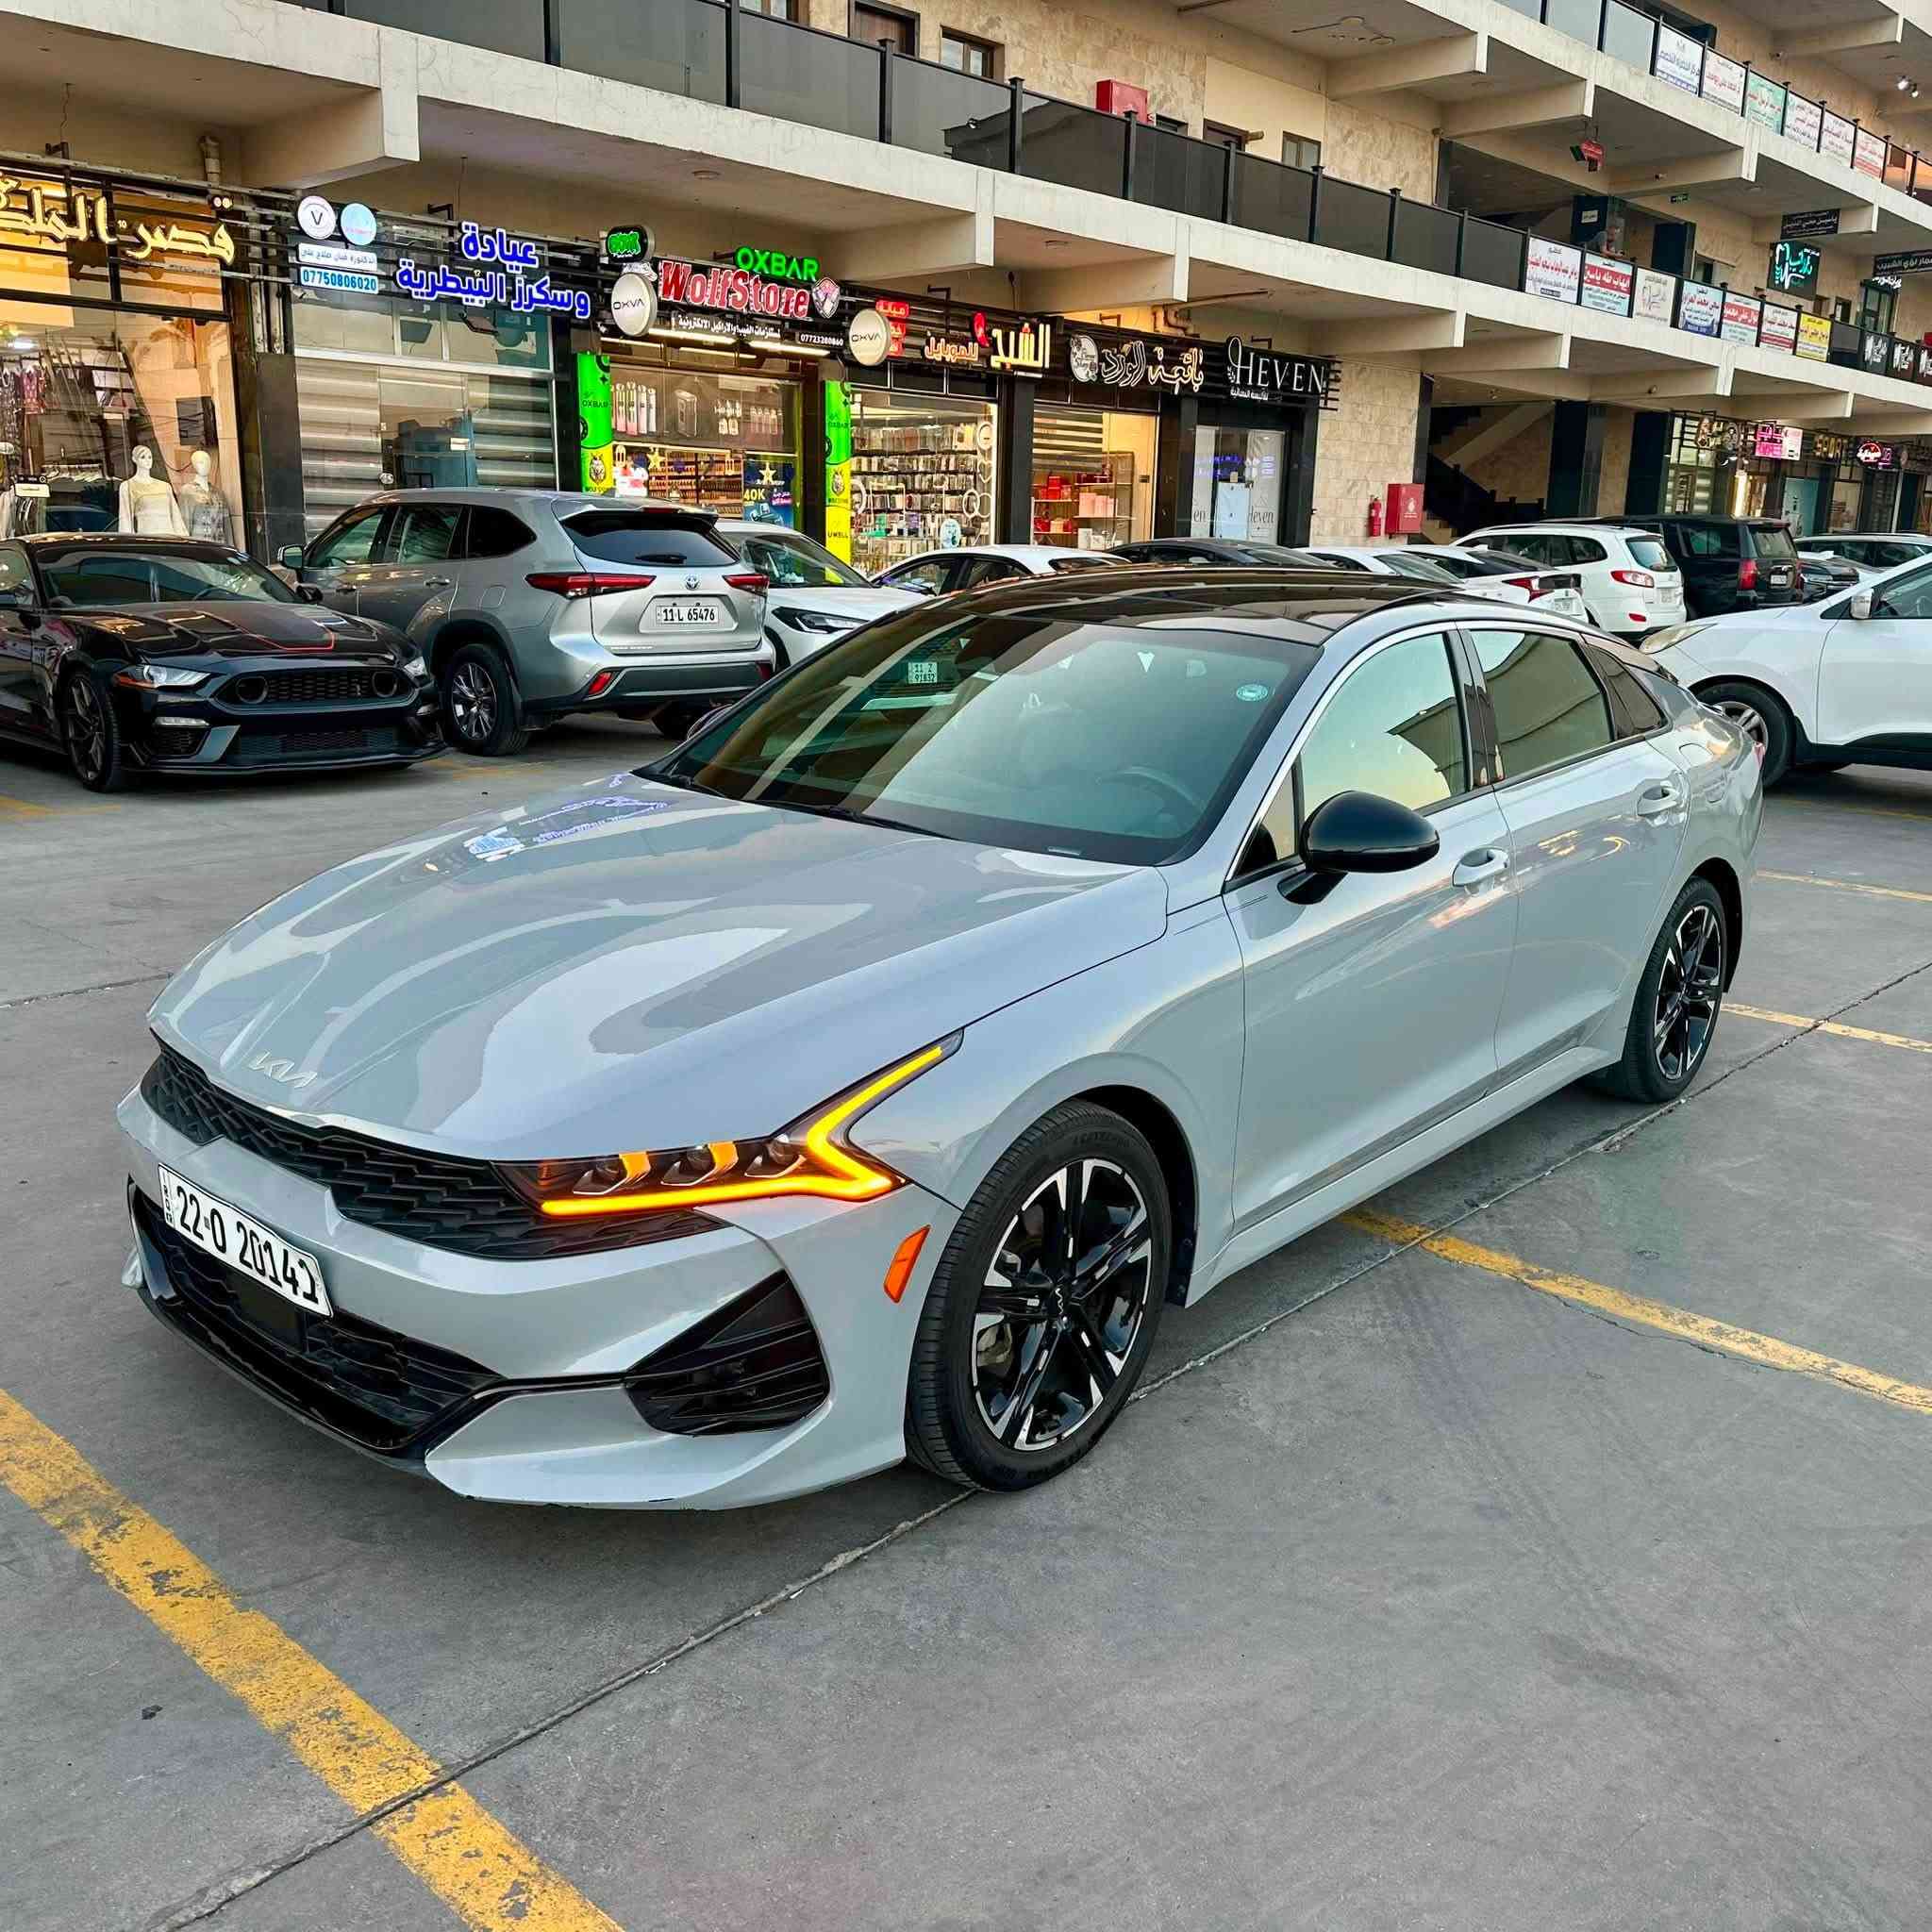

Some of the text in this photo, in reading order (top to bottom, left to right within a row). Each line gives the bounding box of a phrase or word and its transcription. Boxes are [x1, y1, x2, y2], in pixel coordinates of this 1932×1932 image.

[125, 195, 235, 266] قصر
[461, 221, 539, 273] عيادة
[396, 258, 506, 307] البيطرية
[736, 245, 820, 281] OXBAR
[612, 297, 645, 310] OXVA
[659, 259, 810, 319] WolfStore
[851, 332, 882, 342] OXVA
[1228, 337, 1325, 393] HEVEN
[743, 488, 765, 501] 40K
[663, 608, 675, 622] 11
[688, 608, 715, 621] 65476
[176, 1185, 205, 1241] 22
